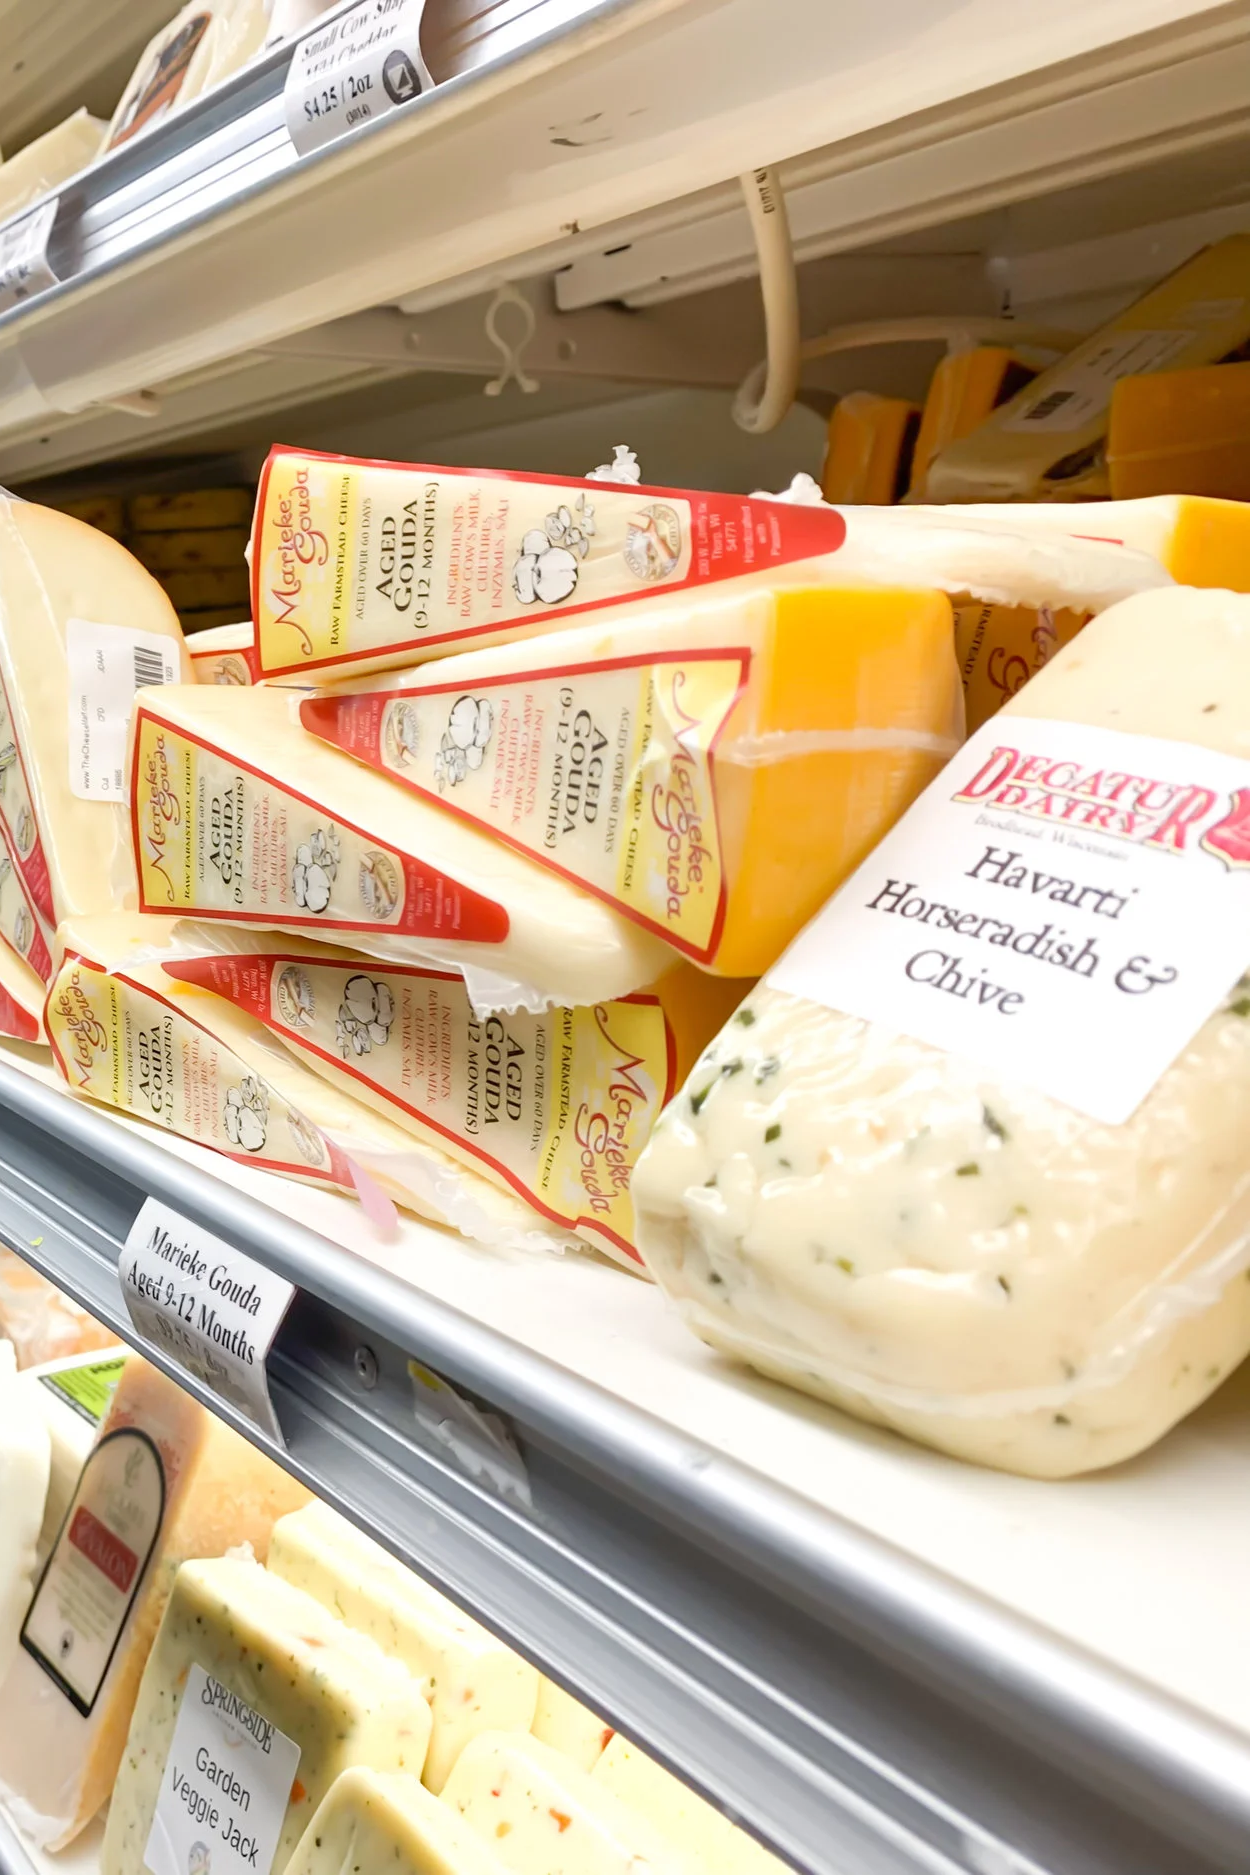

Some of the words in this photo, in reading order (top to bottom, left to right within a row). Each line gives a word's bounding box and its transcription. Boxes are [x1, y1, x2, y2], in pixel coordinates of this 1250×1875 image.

[348, 74, 374, 99] 2oz
[290, 467, 329, 566] Gouda
[361, 532, 370, 547] 60
[362, 497, 372, 530] DAYS
[421, 482, 440, 569] MONTHS)
[271, 499, 313, 656] Marieke
[332, 530, 348, 610] FARMSTEAD
[358, 549, 369, 580] OVER
[375, 516, 397, 599] AGED
[393, 500, 418, 612] GOUDA
[330, 616, 340, 645] RAW
[355, 584, 366, 620] AGED
[413, 578, 431, 629] (9-12
[460, 586, 472, 617] RAW
[523, 694, 534, 728] RAW
[557, 687, 575, 744] (9-12
[617, 707, 631, 751] AGED
[154, 733, 181, 825] Gouda
[543, 753, 564, 849] MONTHS)
[562, 709, 592, 834] GOUDA
[583, 727, 609, 824] AGED
[610, 795, 620, 813] 60
[613, 753, 626, 793] OVER
[669, 670, 712, 884] Marieke
[952, 746, 1217, 855] DECATUR
[145, 759, 175, 902] Marieke
[209, 797, 222, 871] AGED
[220, 788, 234, 885] GOUDA
[235, 775, 245, 853] MONTHS)
[605, 818, 618, 854] DAYS
[986, 784, 1150, 844] DAIRY
[234, 859, 243, 904] (9-12
[622, 827, 639, 891] CHEESE
[652, 783, 690, 920] Gouda
[965, 846, 1141, 919] Havarti
[260, 879, 268, 904] RAW
[865, 879, 1102, 978] Horseradish
[1114, 956, 1178, 994] &
[66, 970, 107, 1052] Gouda
[428, 989, 439, 1021] RAW
[904, 949, 1025, 1016] Chive
[54, 994, 96, 1097] Marieke
[163, 1015, 174, 1086] MONTHS)
[428, 1023, 438, 1068] COW'S
[534, 1023, 546, 1062] AGED
[562, 1007, 575, 1037] RAW
[111, 1029, 120, 1093] FARMSTEAD
[138, 1031, 151, 1099] AGED
[150, 1026, 164, 1114] GOUDA
[401, 1056, 413, 1090] SALT
[464, 1049, 480, 1136] MONTHS)
[484, 1016, 504, 1125] GOUDA
[506, 1034, 526, 1122] AGED
[533, 1064, 546, 1100] OVER
[558, 1044, 573, 1130] FARMSTEAD
[533, 1100, 543, 1119] 60
[594, 1005, 648, 1193] Marieke
[541, 1135, 561, 1190] CHEESE
[574, 1102, 618, 1214] Gouda
[146, 1226, 208, 1281] Marieke
[209, 1265, 262, 1316] Gouda
[128, 1260, 164, 1301] Aged
[163, 1282, 196, 1324] 9-12
[196, 1303, 255, 1366] Months
[201, 1675, 276, 1755] SPRINGSIDE
[196, 1747, 251, 1812] Garden
[172, 1766, 219, 1829] Veggie
[221, 1817, 260, 1869] Jack
